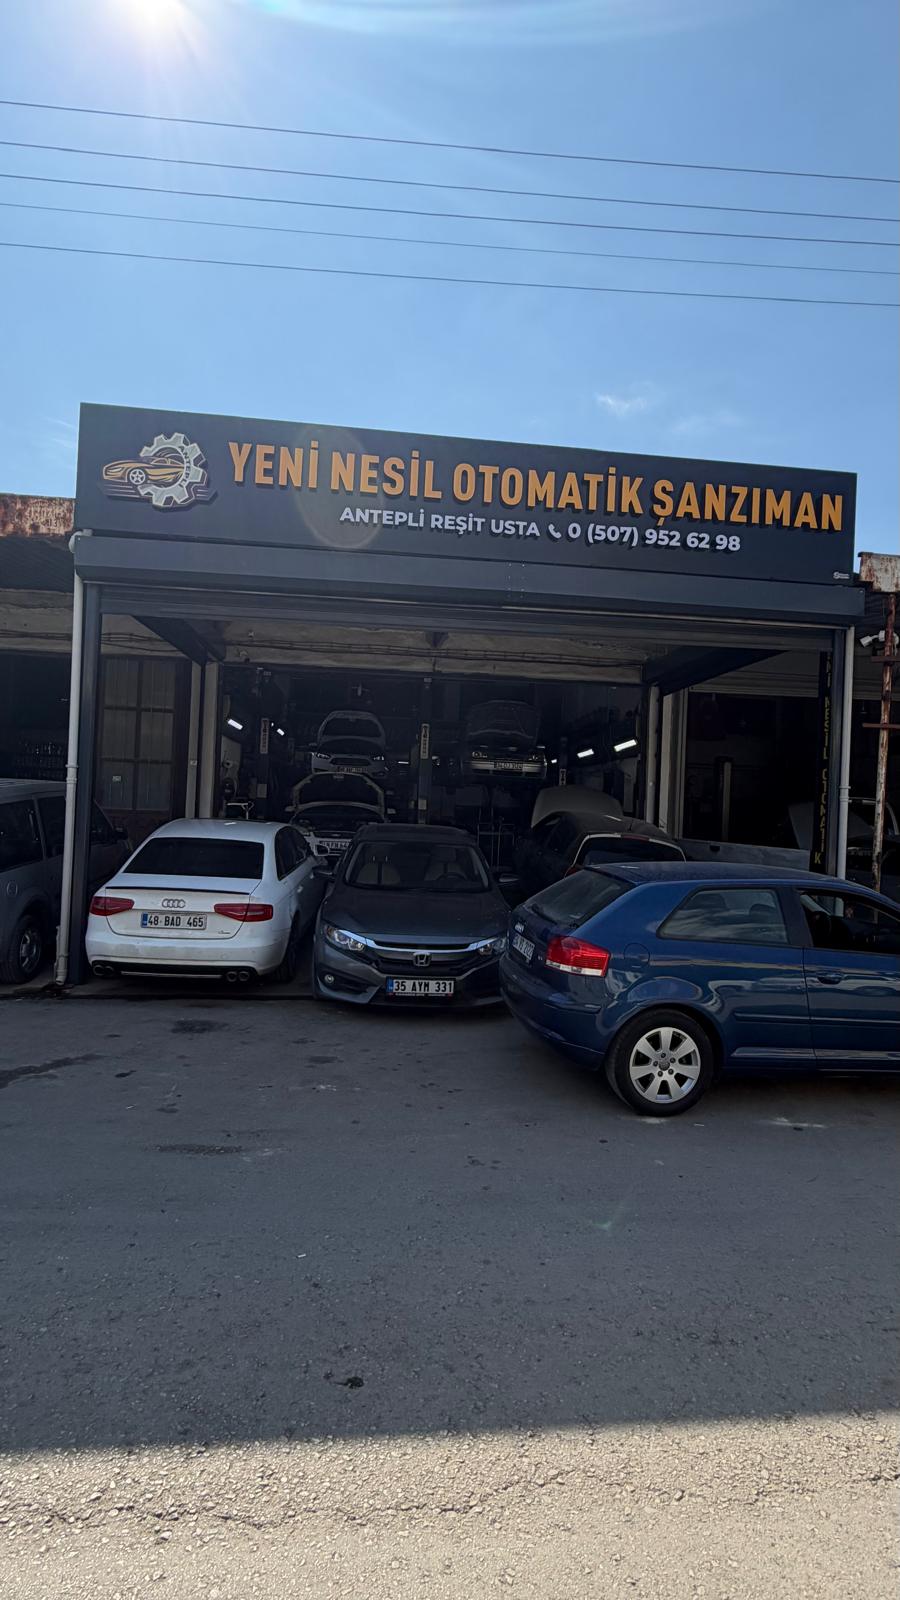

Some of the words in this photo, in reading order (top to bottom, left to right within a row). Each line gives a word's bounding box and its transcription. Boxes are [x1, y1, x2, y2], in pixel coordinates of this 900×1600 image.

[230, 440, 317, 488] YENİ
[331, 450, 441, 499] NESİL
[453, 463, 643, 514] OTOMATİK
[653, 479, 843, 531] ŞANZIMAN
[339, 506, 425, 528] ANTEPLİ
[430, 513, 486, 535] REŞİT
[491, 519, 541, 537] USTA
[567, 522, 582, 539] 0
[587, 523, 639, 547] (507)
[645, 528, 681, 547] 952
[686, 532, 710, 549] 62
[715, 534, 741, 551] 98
[148, 915, 159, 926] 48
[187, 916, 204, 928] 465
[394, 980, 407, 992] 35
[411, 981, 430, 992] AYM
[435, 981, 452, 993] 331
